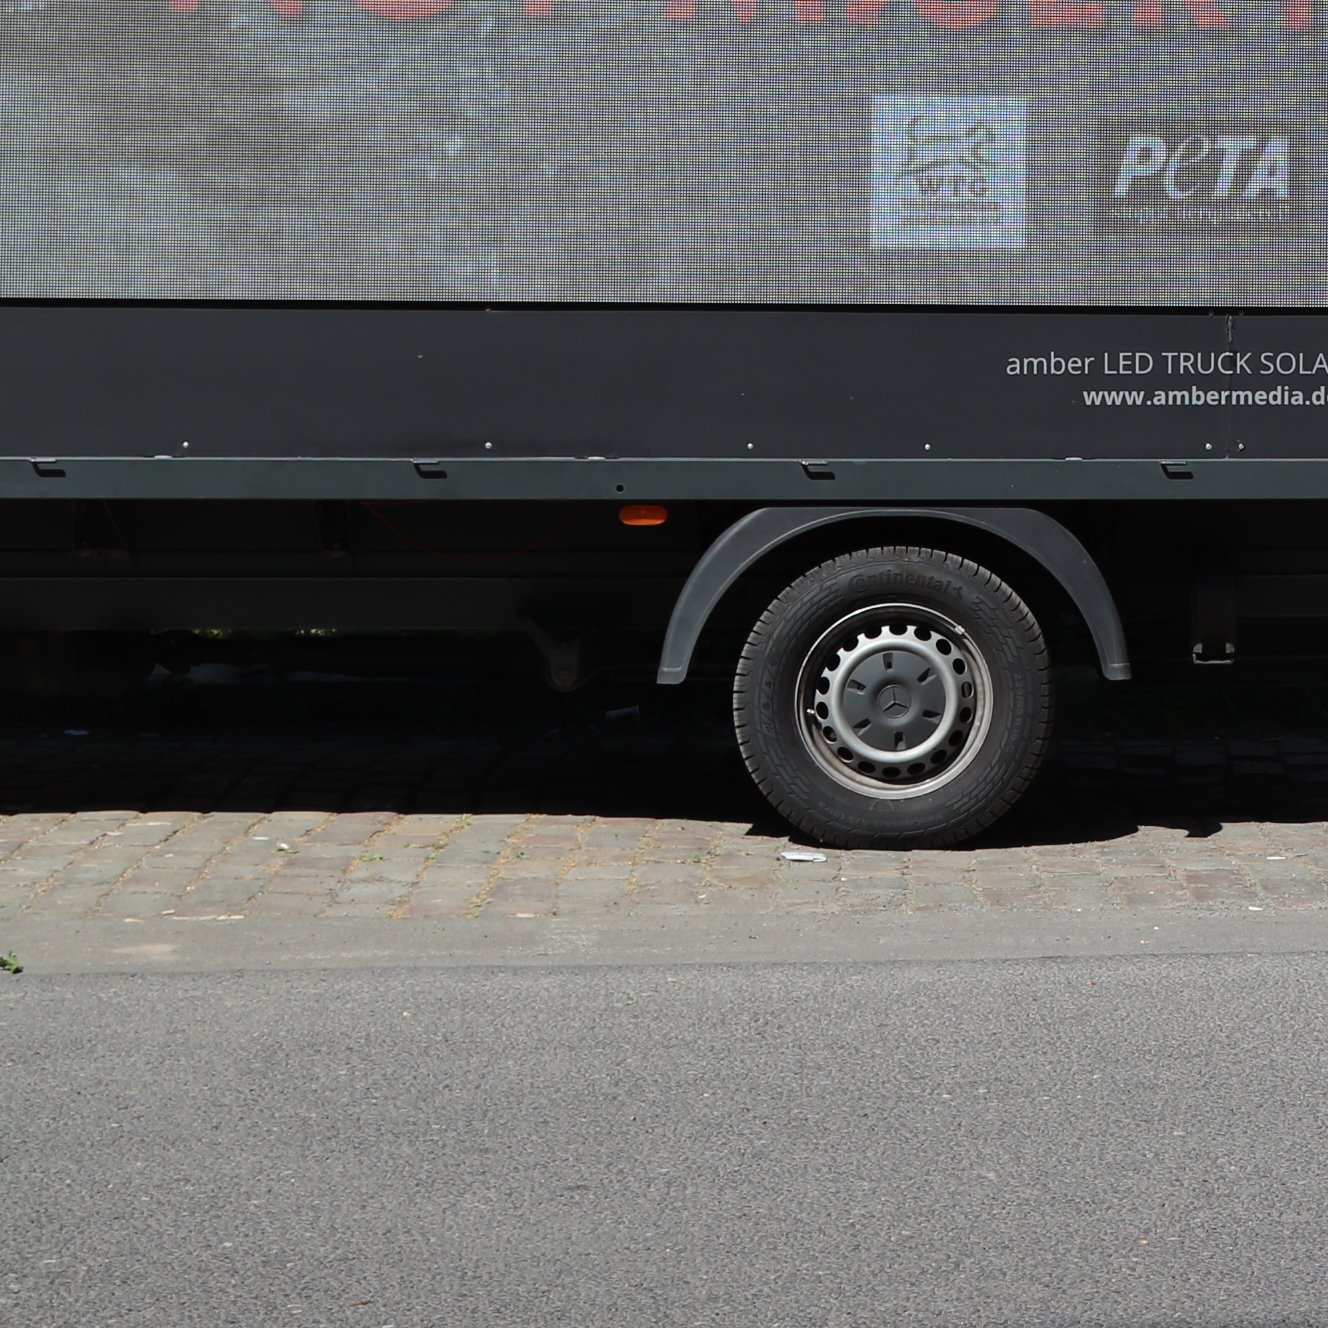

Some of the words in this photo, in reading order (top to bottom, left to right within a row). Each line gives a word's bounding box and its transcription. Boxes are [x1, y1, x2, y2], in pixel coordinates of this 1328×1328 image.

[1005, 352, 1095, 375] amber
[1104, 352, 1154, 375] LED
[1161, 352, 1253, 375] TRUCK
